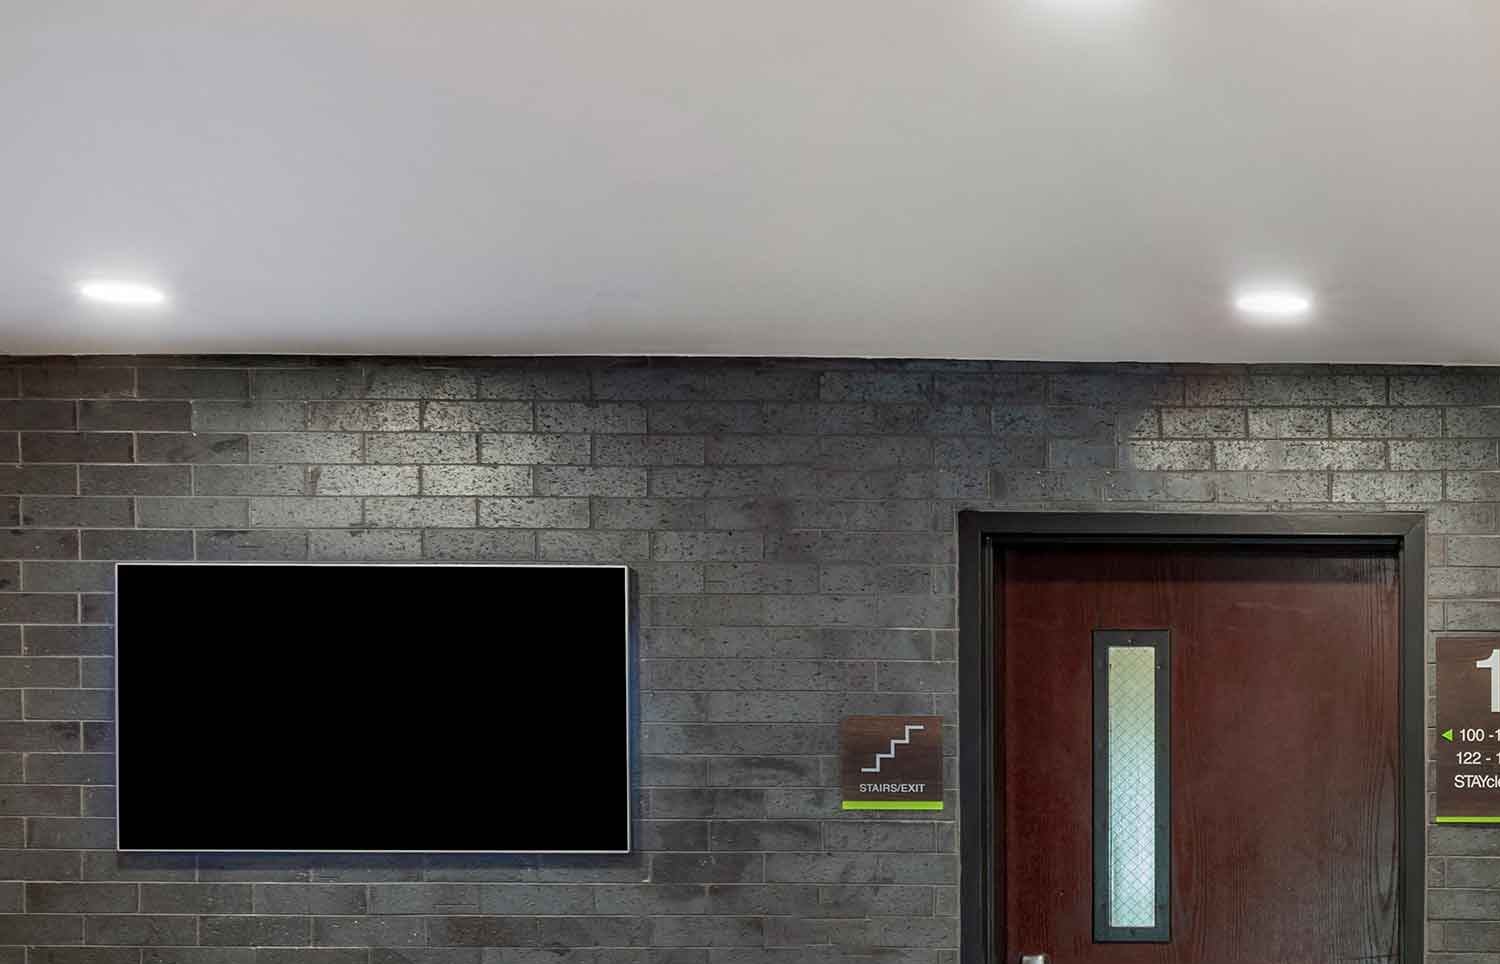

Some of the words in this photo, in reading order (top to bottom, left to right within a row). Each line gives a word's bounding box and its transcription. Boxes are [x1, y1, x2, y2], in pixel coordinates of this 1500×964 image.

[1475, 648, 1500, 713] 1
[1459, 728, 1485, 742] 100
[1456, 752, 1482, 765] 122
[859, 783, 926, 793] STAIRS/EXIT
